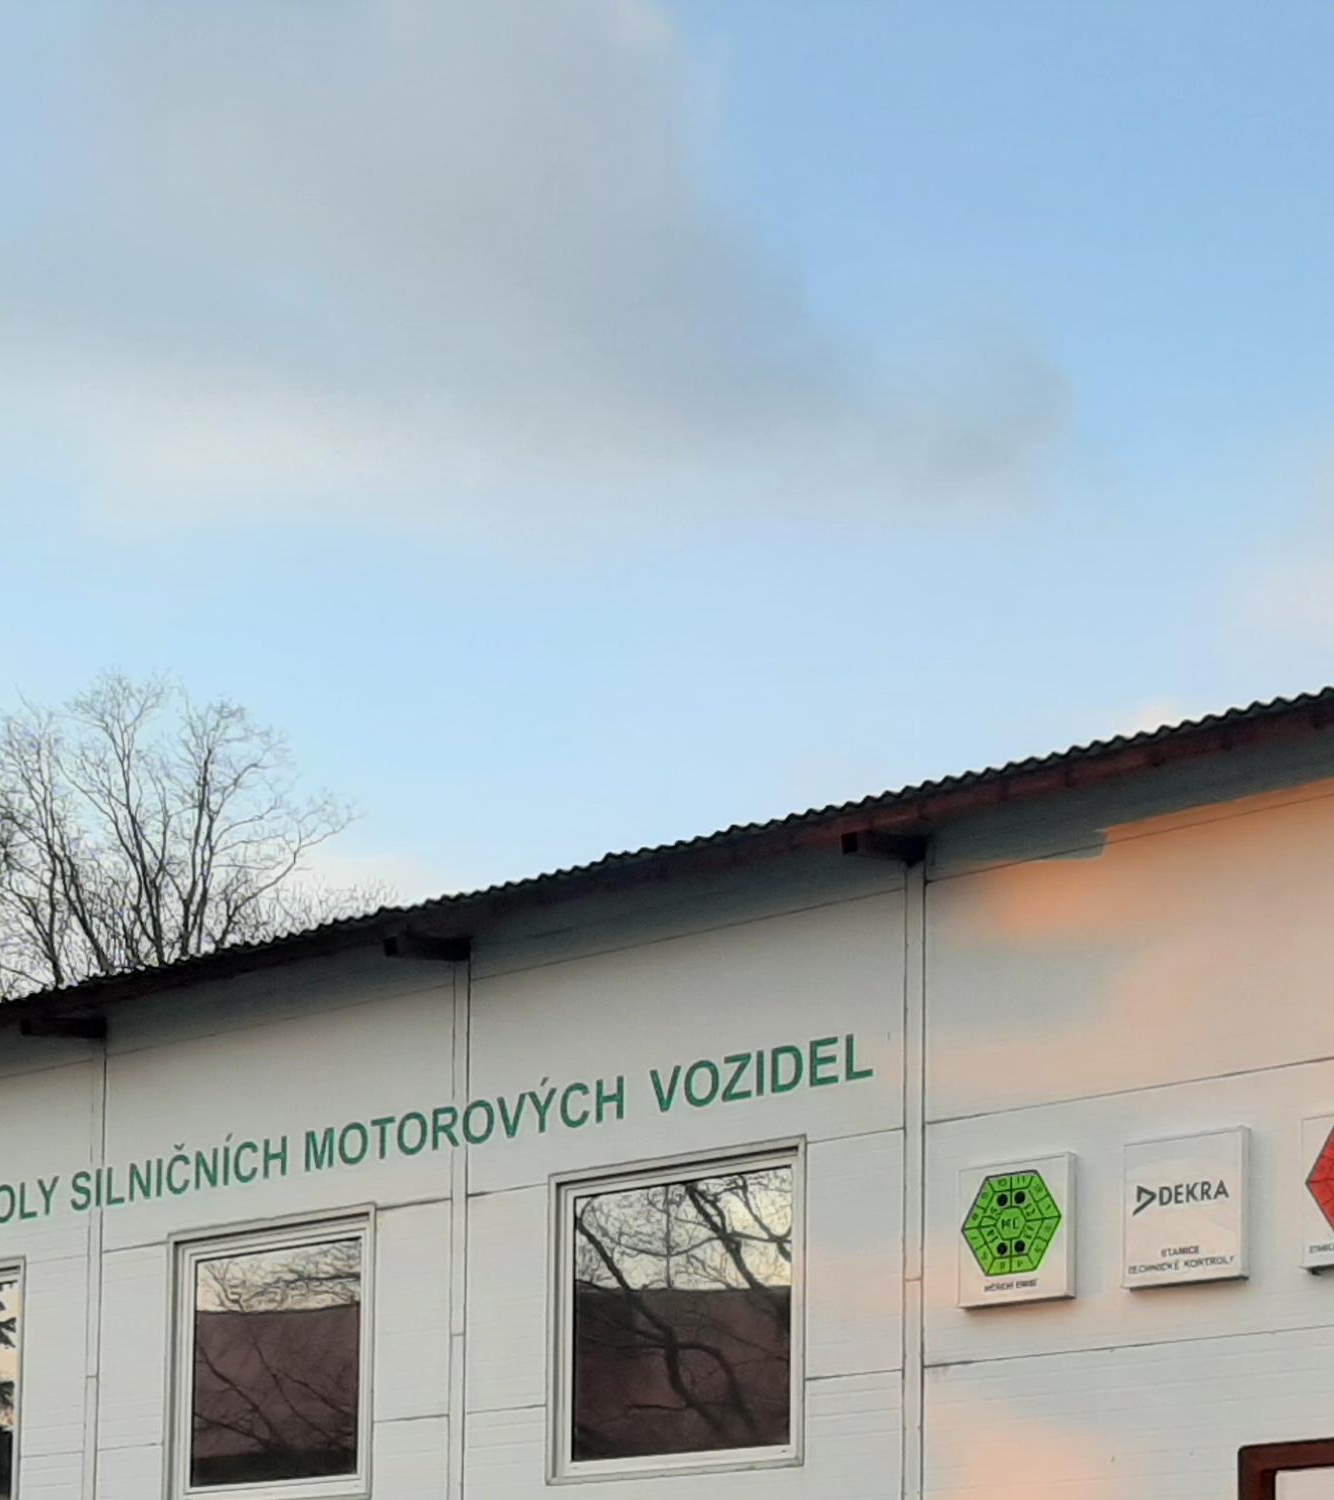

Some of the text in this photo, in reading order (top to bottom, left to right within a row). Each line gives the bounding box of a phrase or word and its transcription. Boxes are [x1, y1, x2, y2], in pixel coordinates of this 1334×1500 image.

[73, 1134, 289, 1214] SILNIČNÍCH
[305, 1077, 628, 1173] MOTOROVÝCH
[650, 1034, 875, 1112] VOZIDEL
[1158, 1179, 1230, 1206] DEKRA
